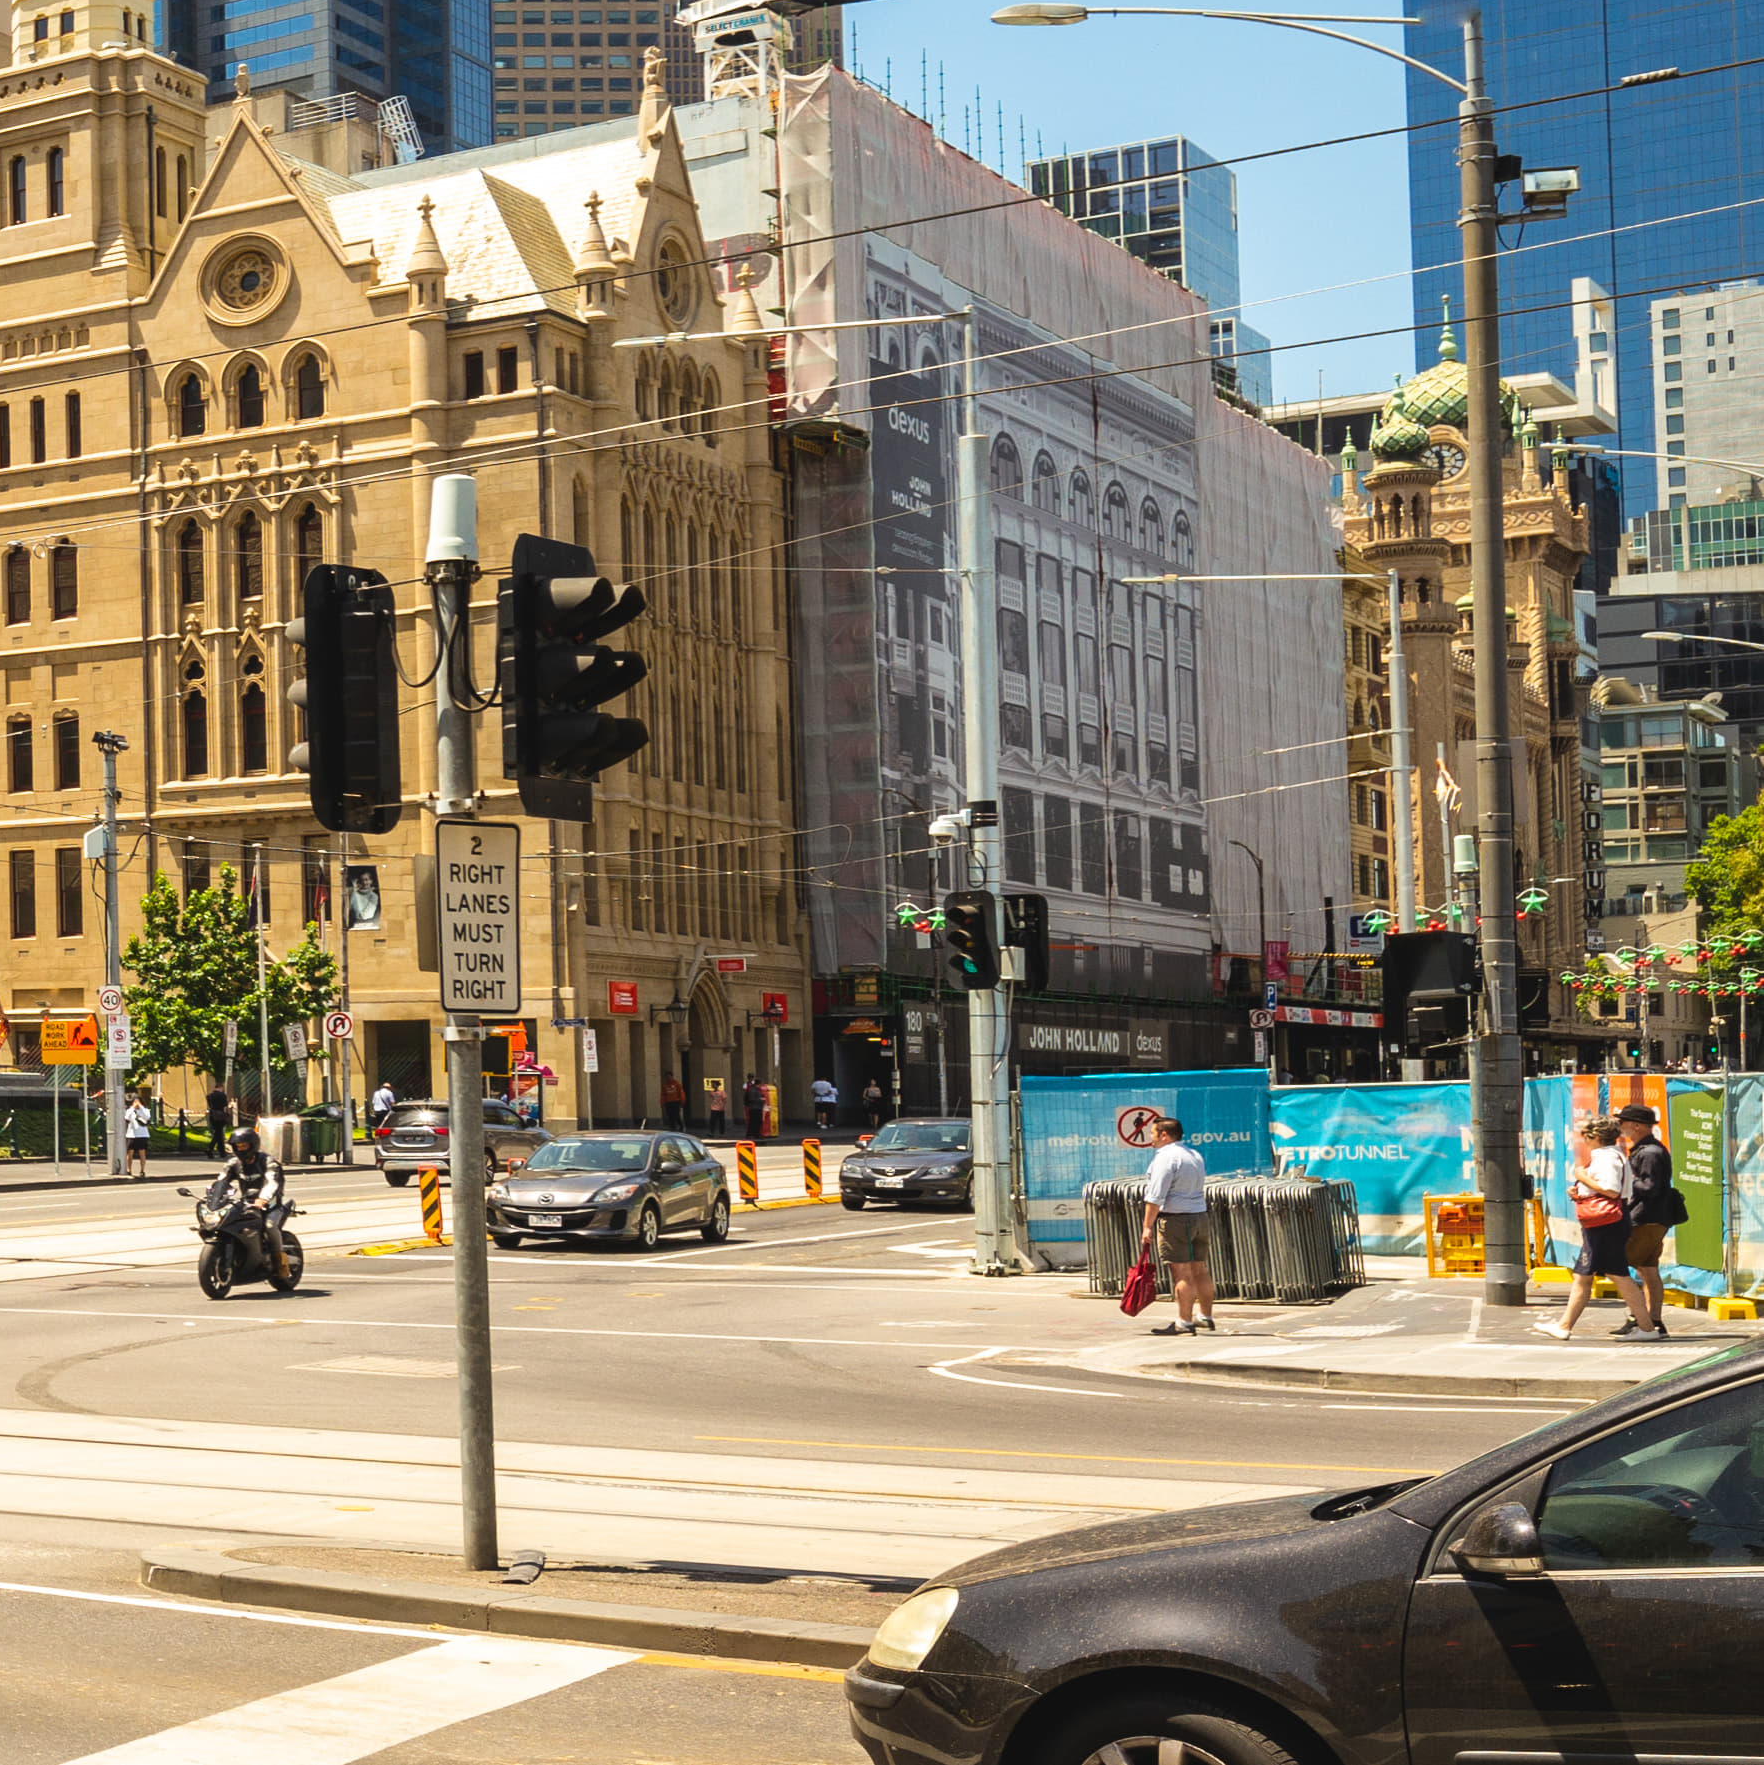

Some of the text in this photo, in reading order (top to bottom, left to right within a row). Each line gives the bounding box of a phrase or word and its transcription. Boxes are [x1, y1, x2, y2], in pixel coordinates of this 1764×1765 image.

[705, 21, 733, 34] SELECT
[888, 401, 930, 445] dexus
[909, 475, 932, 497] JOHN
[891, 489, 932, 518] HOLLAND
[470, 836, 483, 856] 2
[1584, 784, 1604, 919] FORUM
[449, 863, 505, 885] RIGHT
[446, 893, 511, 915] LANES
[452, 922, 504, 944] MUST
[454, 952, 504, 973] TURN
[103, 995, 118, 1006] 40
[452, 979, 506, 1000] RIGHT
[906, 1011, 922, 1032] 180
[43, 1040, 67, 1048] AHEAD
[1029, 1026, 1121, 1054] JOHN HOLLAND
[1136, 1030, 1162, 1053] dexus
